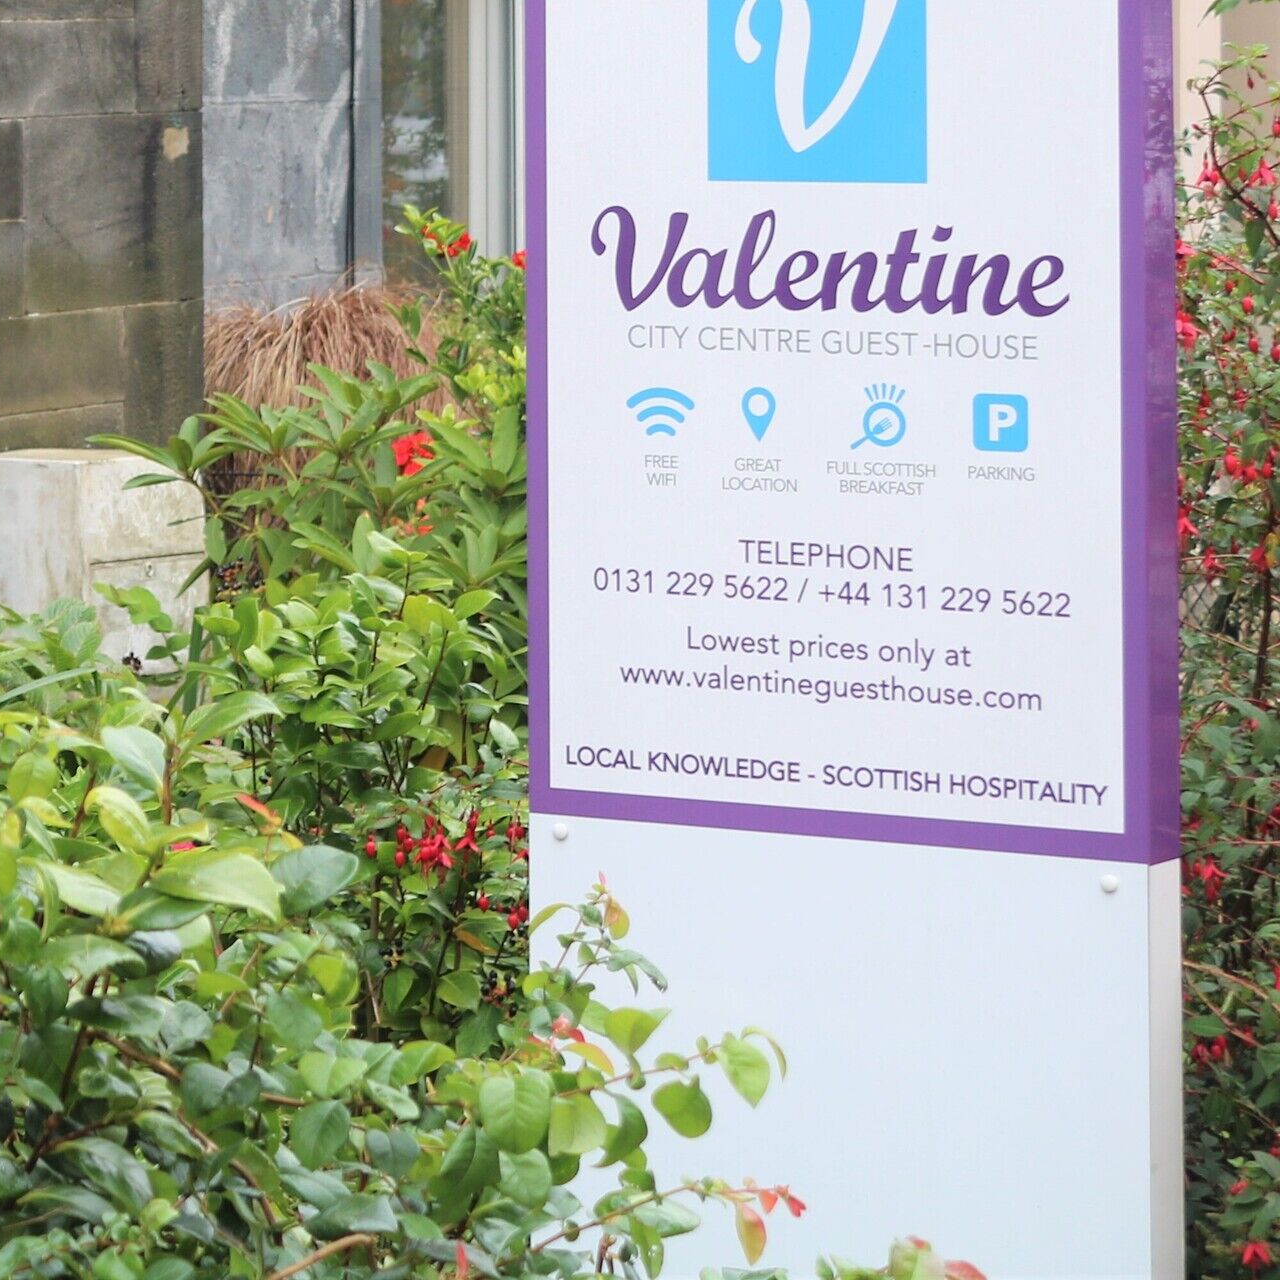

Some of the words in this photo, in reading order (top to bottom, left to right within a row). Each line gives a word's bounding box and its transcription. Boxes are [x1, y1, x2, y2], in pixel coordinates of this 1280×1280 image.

[591, 205, 1070, 317] Valentine
[627, 324, 689, 349] CITY
[698, 327, 812, 353] CENTRE
[644, 455, 678, 469] FREE
[734, 458, 781, 472] GREAT
[826, 460, 861, 476] FULL
[863, 462, 936, 478] SCOTTISH
[967, 466, 1035, 481] PARKING
[646, 472, 677, 486] WIFI
[721, 477, 797, 492] LOCATION
[840, 480, 924, 495] BREAKFAST
[738, 539, 914, 572] TELEPHONE
[593, 566, 653, 594] 0131
[666, 570, 714, 597] 229
[724, 574, 789, 602] 5622
[797, 577, 809, 603] /
[818, 581, 871, 606] +44
[882, 583, 926, 610] 131
[940, 586, 992, 613] 229
[1002, 590, 1071, 618] 5622
[687, 626, 780, 656] Lowest
[789, 634, 869, 663] prices
[878, 638, 936, 672] only
[944, 645, 972, 668] at
[620, 664, 1043, 711] www.valentineguesthouse.com
[565, 744, 641, 771] LOCAL
[647, 751, 801, 783] KNOWLEDGE
[822, 764, 941, 794] SCOTTISH
[949, 773, 1109, 806] HOSPITALITY
